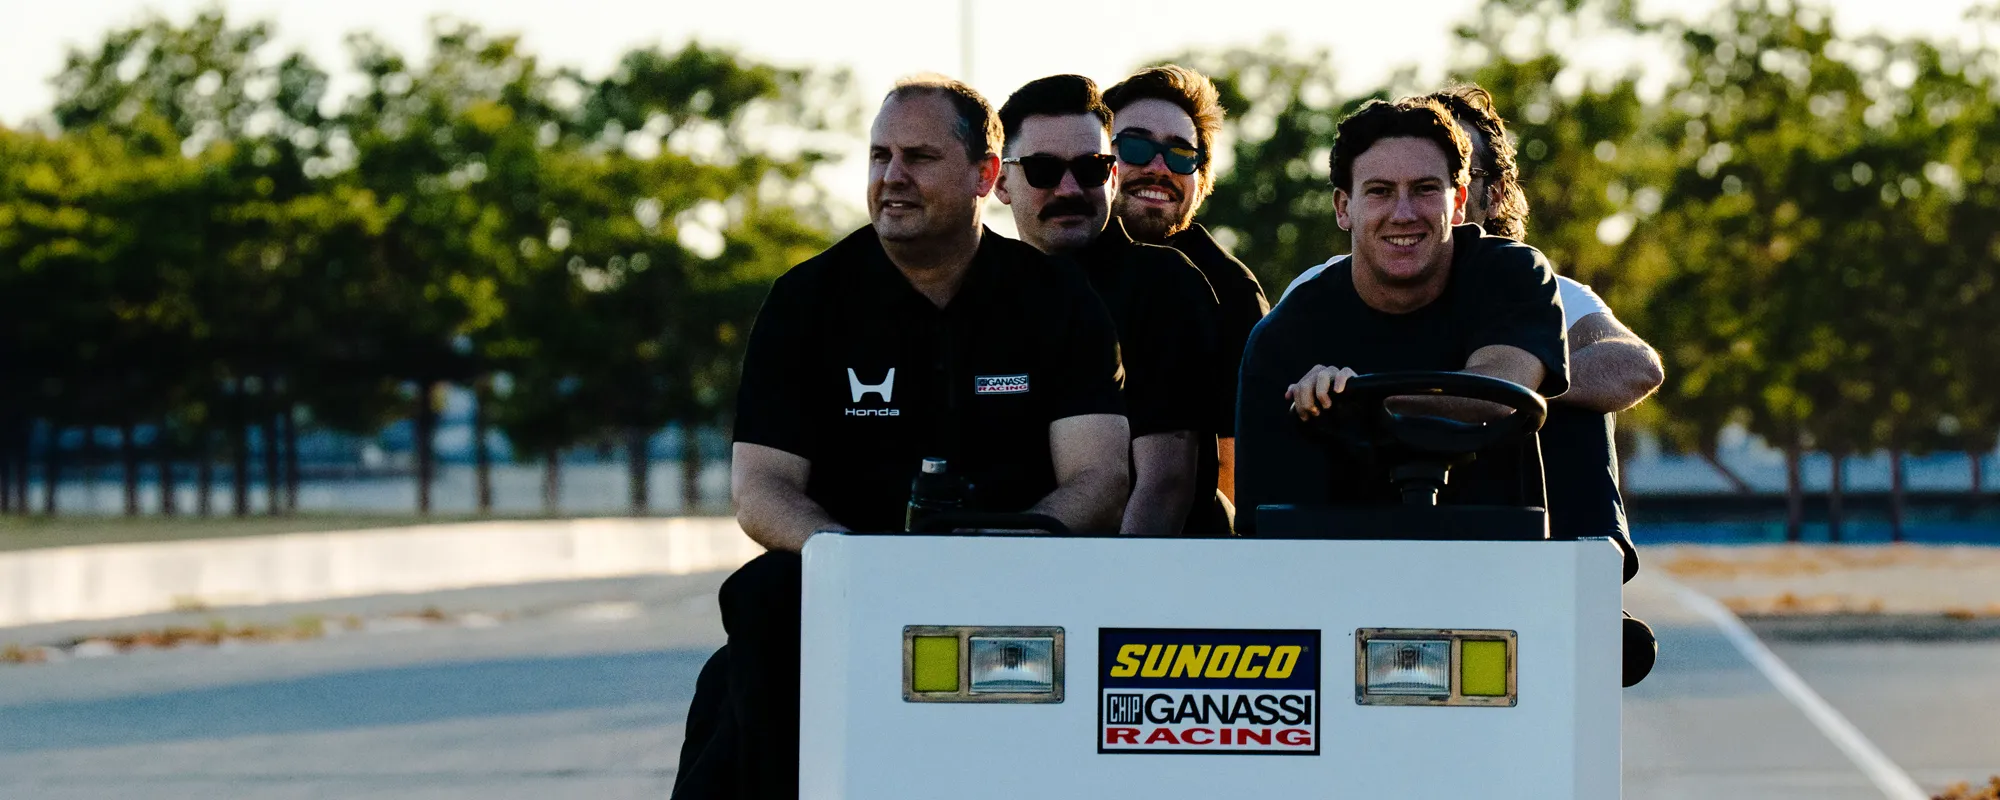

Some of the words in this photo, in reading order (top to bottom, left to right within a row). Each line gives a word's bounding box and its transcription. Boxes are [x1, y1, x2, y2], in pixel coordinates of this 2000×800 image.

[845, 408, 900, 416] Honda
[1109, 644, 1302, 679] SUNOCO
[1109, 696, 1140, 723] CHIP
[1144, 693, 1312, 726] GANASSI
[1106, 728, 1312, 746] RACING
